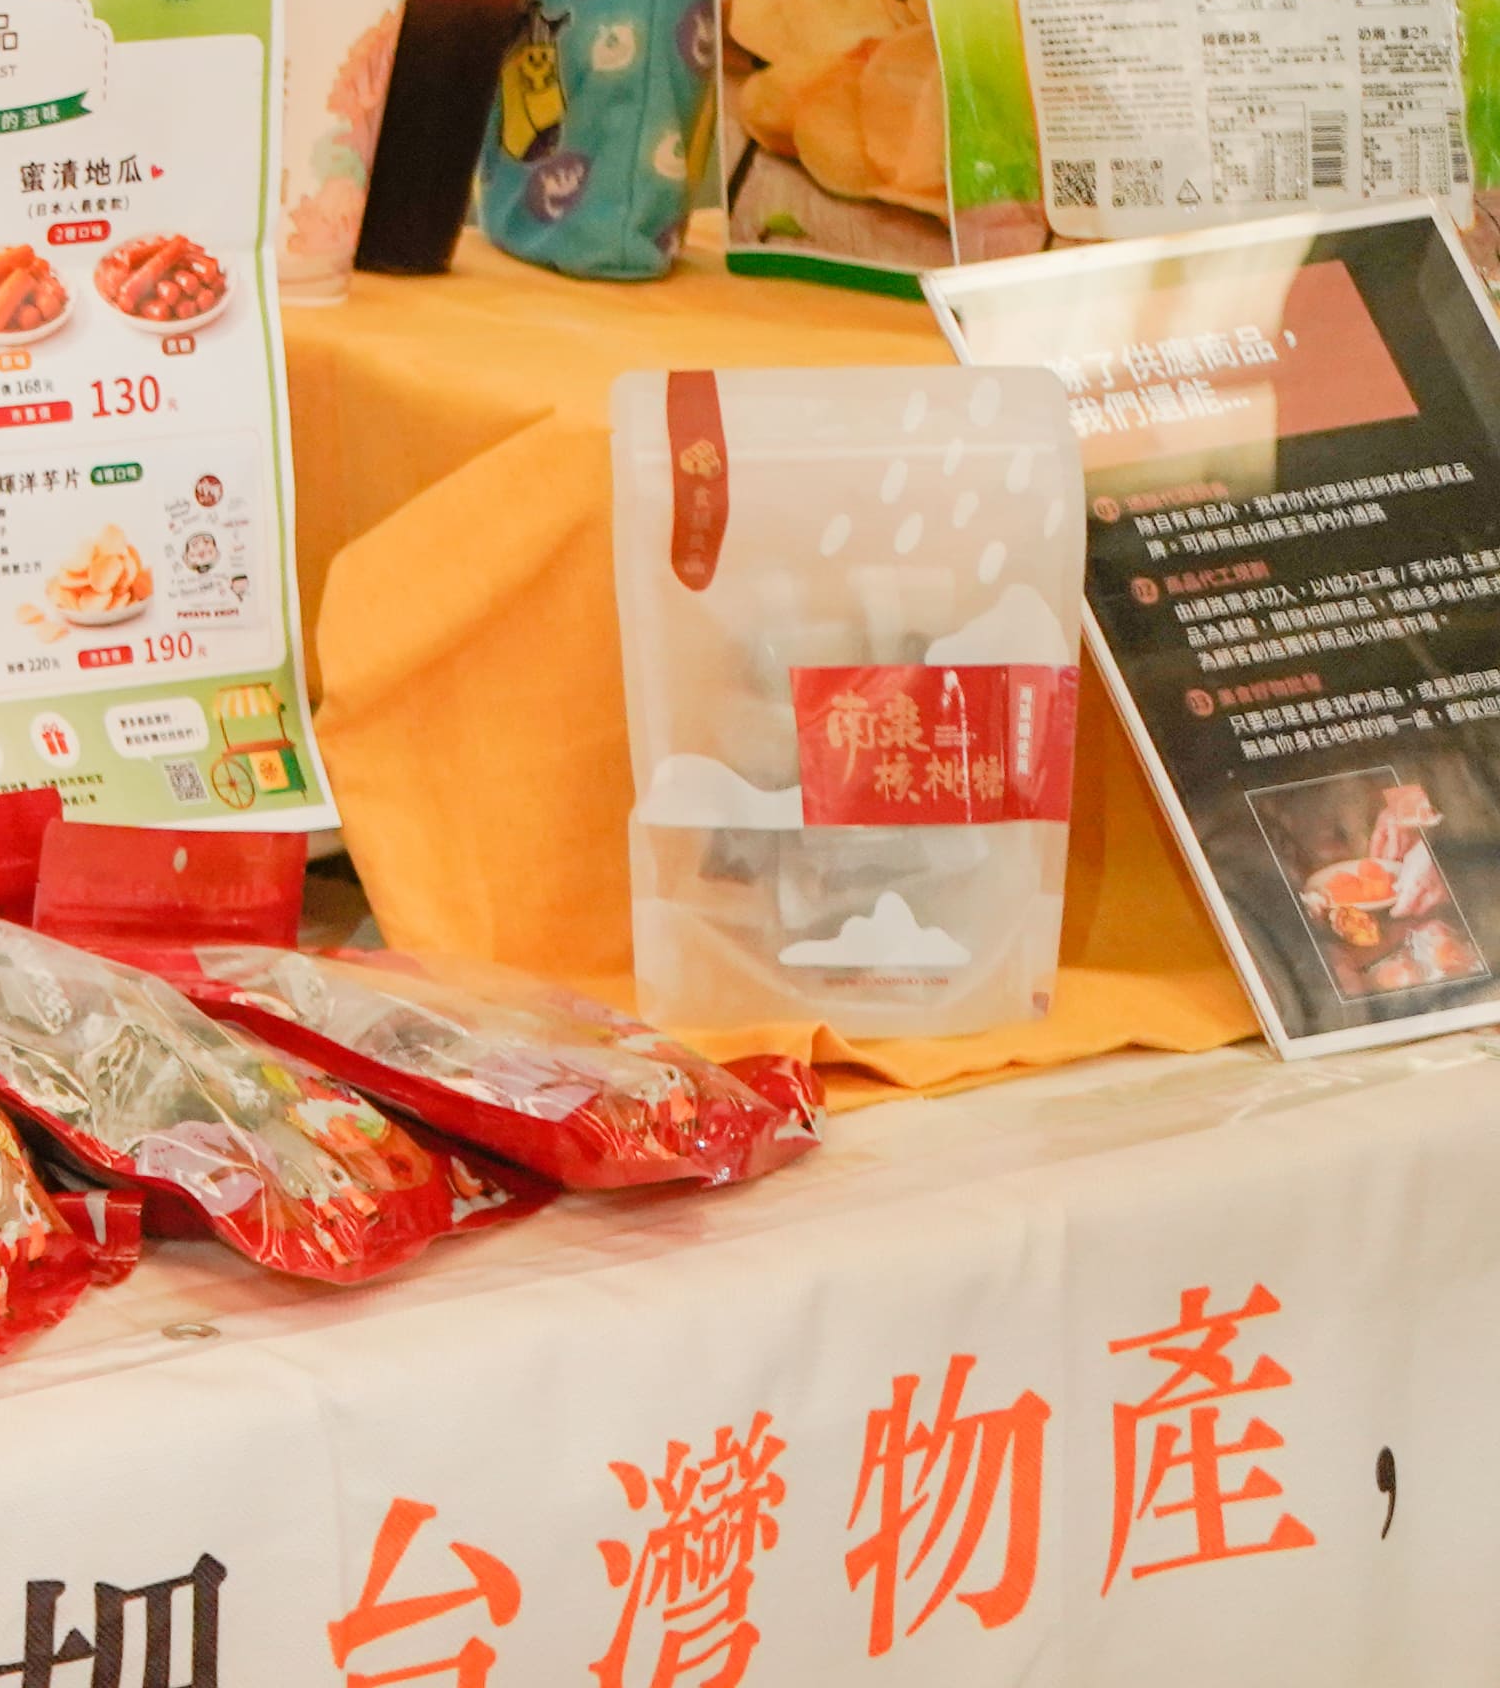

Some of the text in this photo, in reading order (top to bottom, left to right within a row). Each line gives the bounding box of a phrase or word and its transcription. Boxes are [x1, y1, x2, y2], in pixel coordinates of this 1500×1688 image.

[19, 155, 142, 193] 蜜漬地瓜
[90, 375, 161, 418] 130
[1463, 548, 1500, 573] 生產
[143, 630, 193, 664] 190
